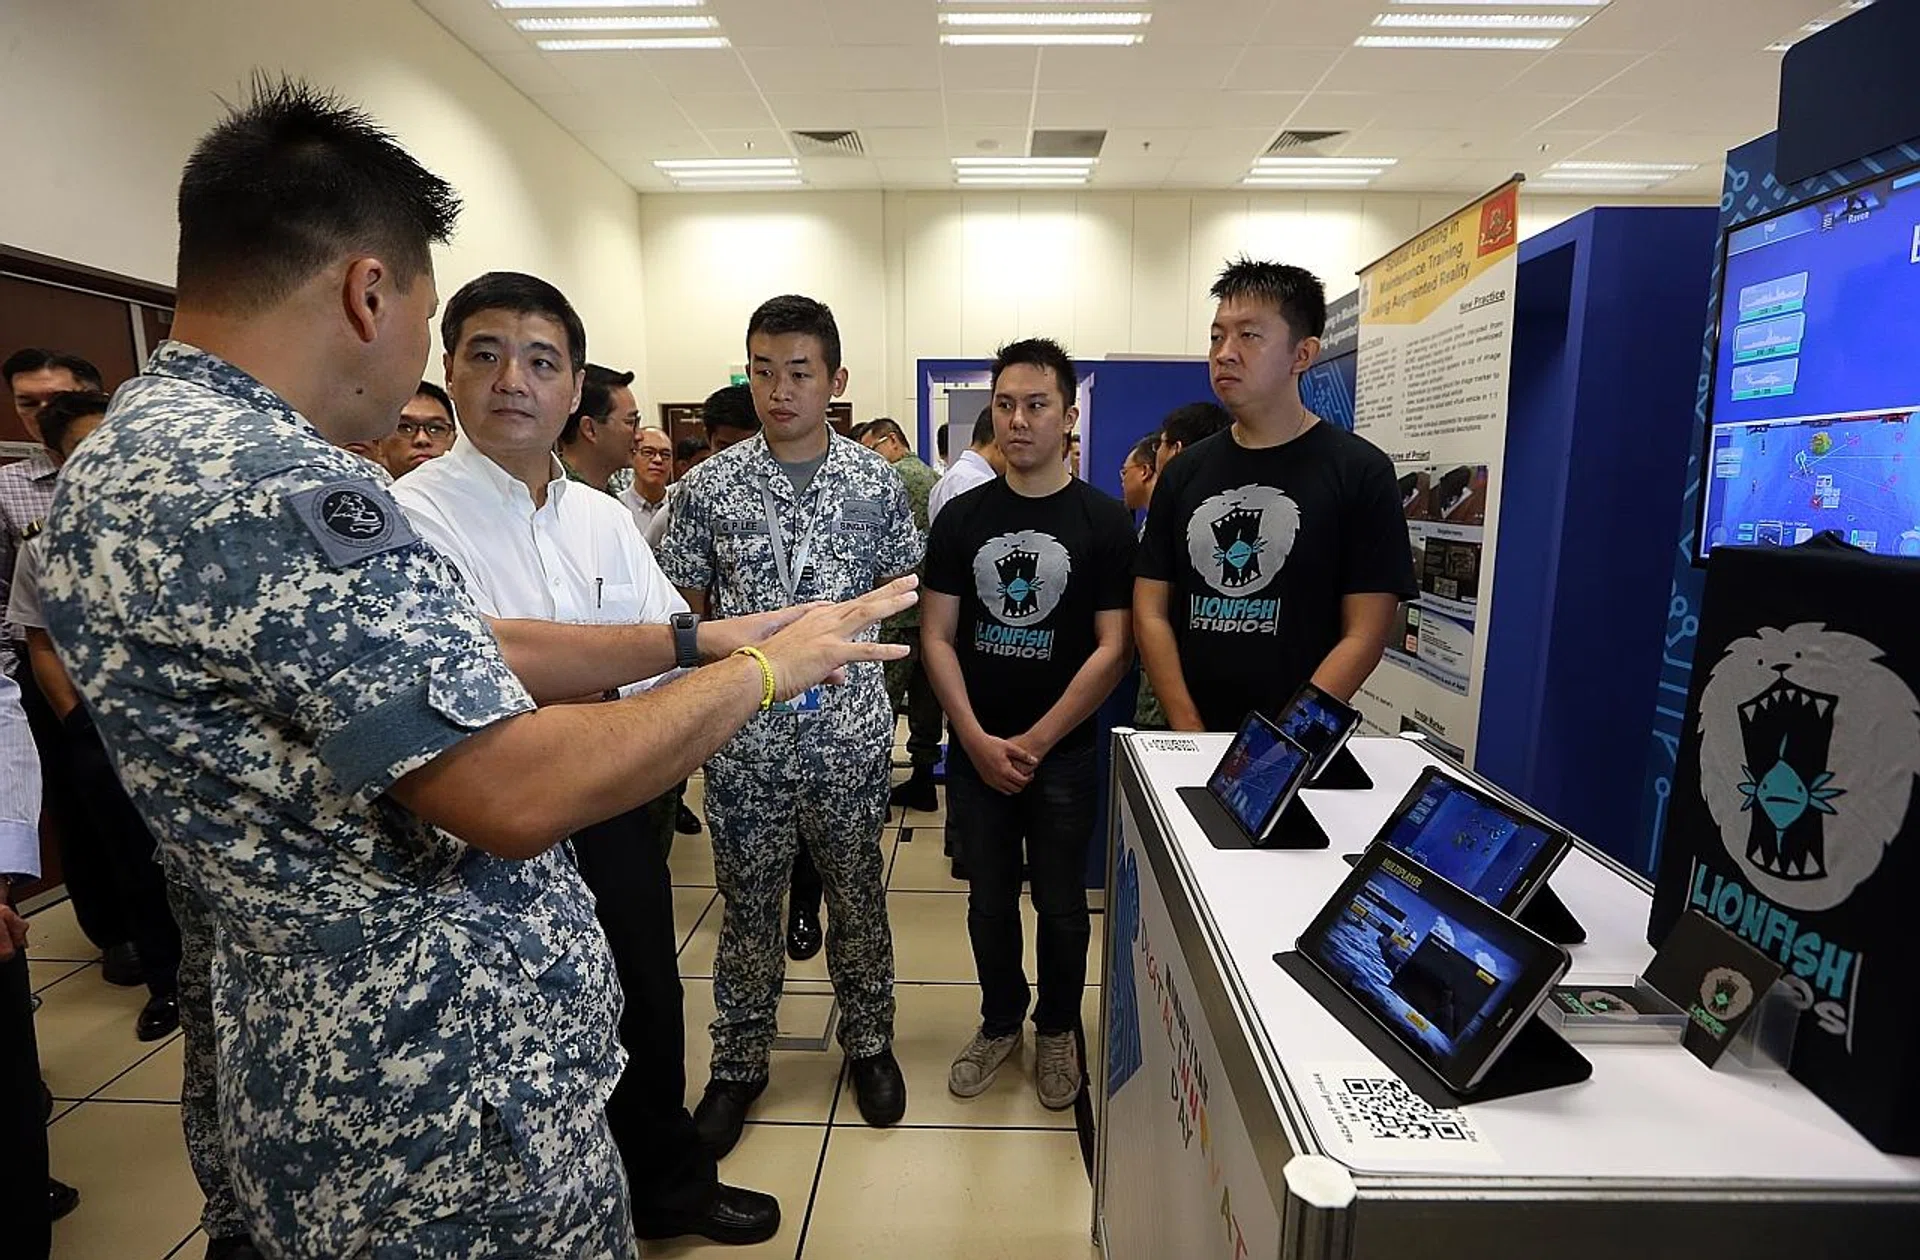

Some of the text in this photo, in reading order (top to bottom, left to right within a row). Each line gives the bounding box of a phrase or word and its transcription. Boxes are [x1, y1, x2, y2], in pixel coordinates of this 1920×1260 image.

[1411, 225, 1449, 257] Learning
[1450, 219, 1460, 236] in
[1380, 240, 1464, 294] Maintenance Training
[1391, 276, 1438, 308] Augmented
[1440, 261, 1471, 288] Reality
[1474, 289, 1506, 307] Practice
[732, 522, 738, 531] P
[741, 522, 757, 531] LEE
[1193, 595, 1276, 619] LIONFISH
[978, 621, 1052, 648] LIONFISH
[1191, 617, 1275, 633] STUDIOS
[975, 640, 1050, 660] STUDIOS
[1381, 857, 1423, 888] MULTIPLAYER
[1691, 863, 1854, 999] LIONFISH
[1140, 917, 1176, 1055] DIGITAL
[1170, 1066, 1194, 1150] DAY
